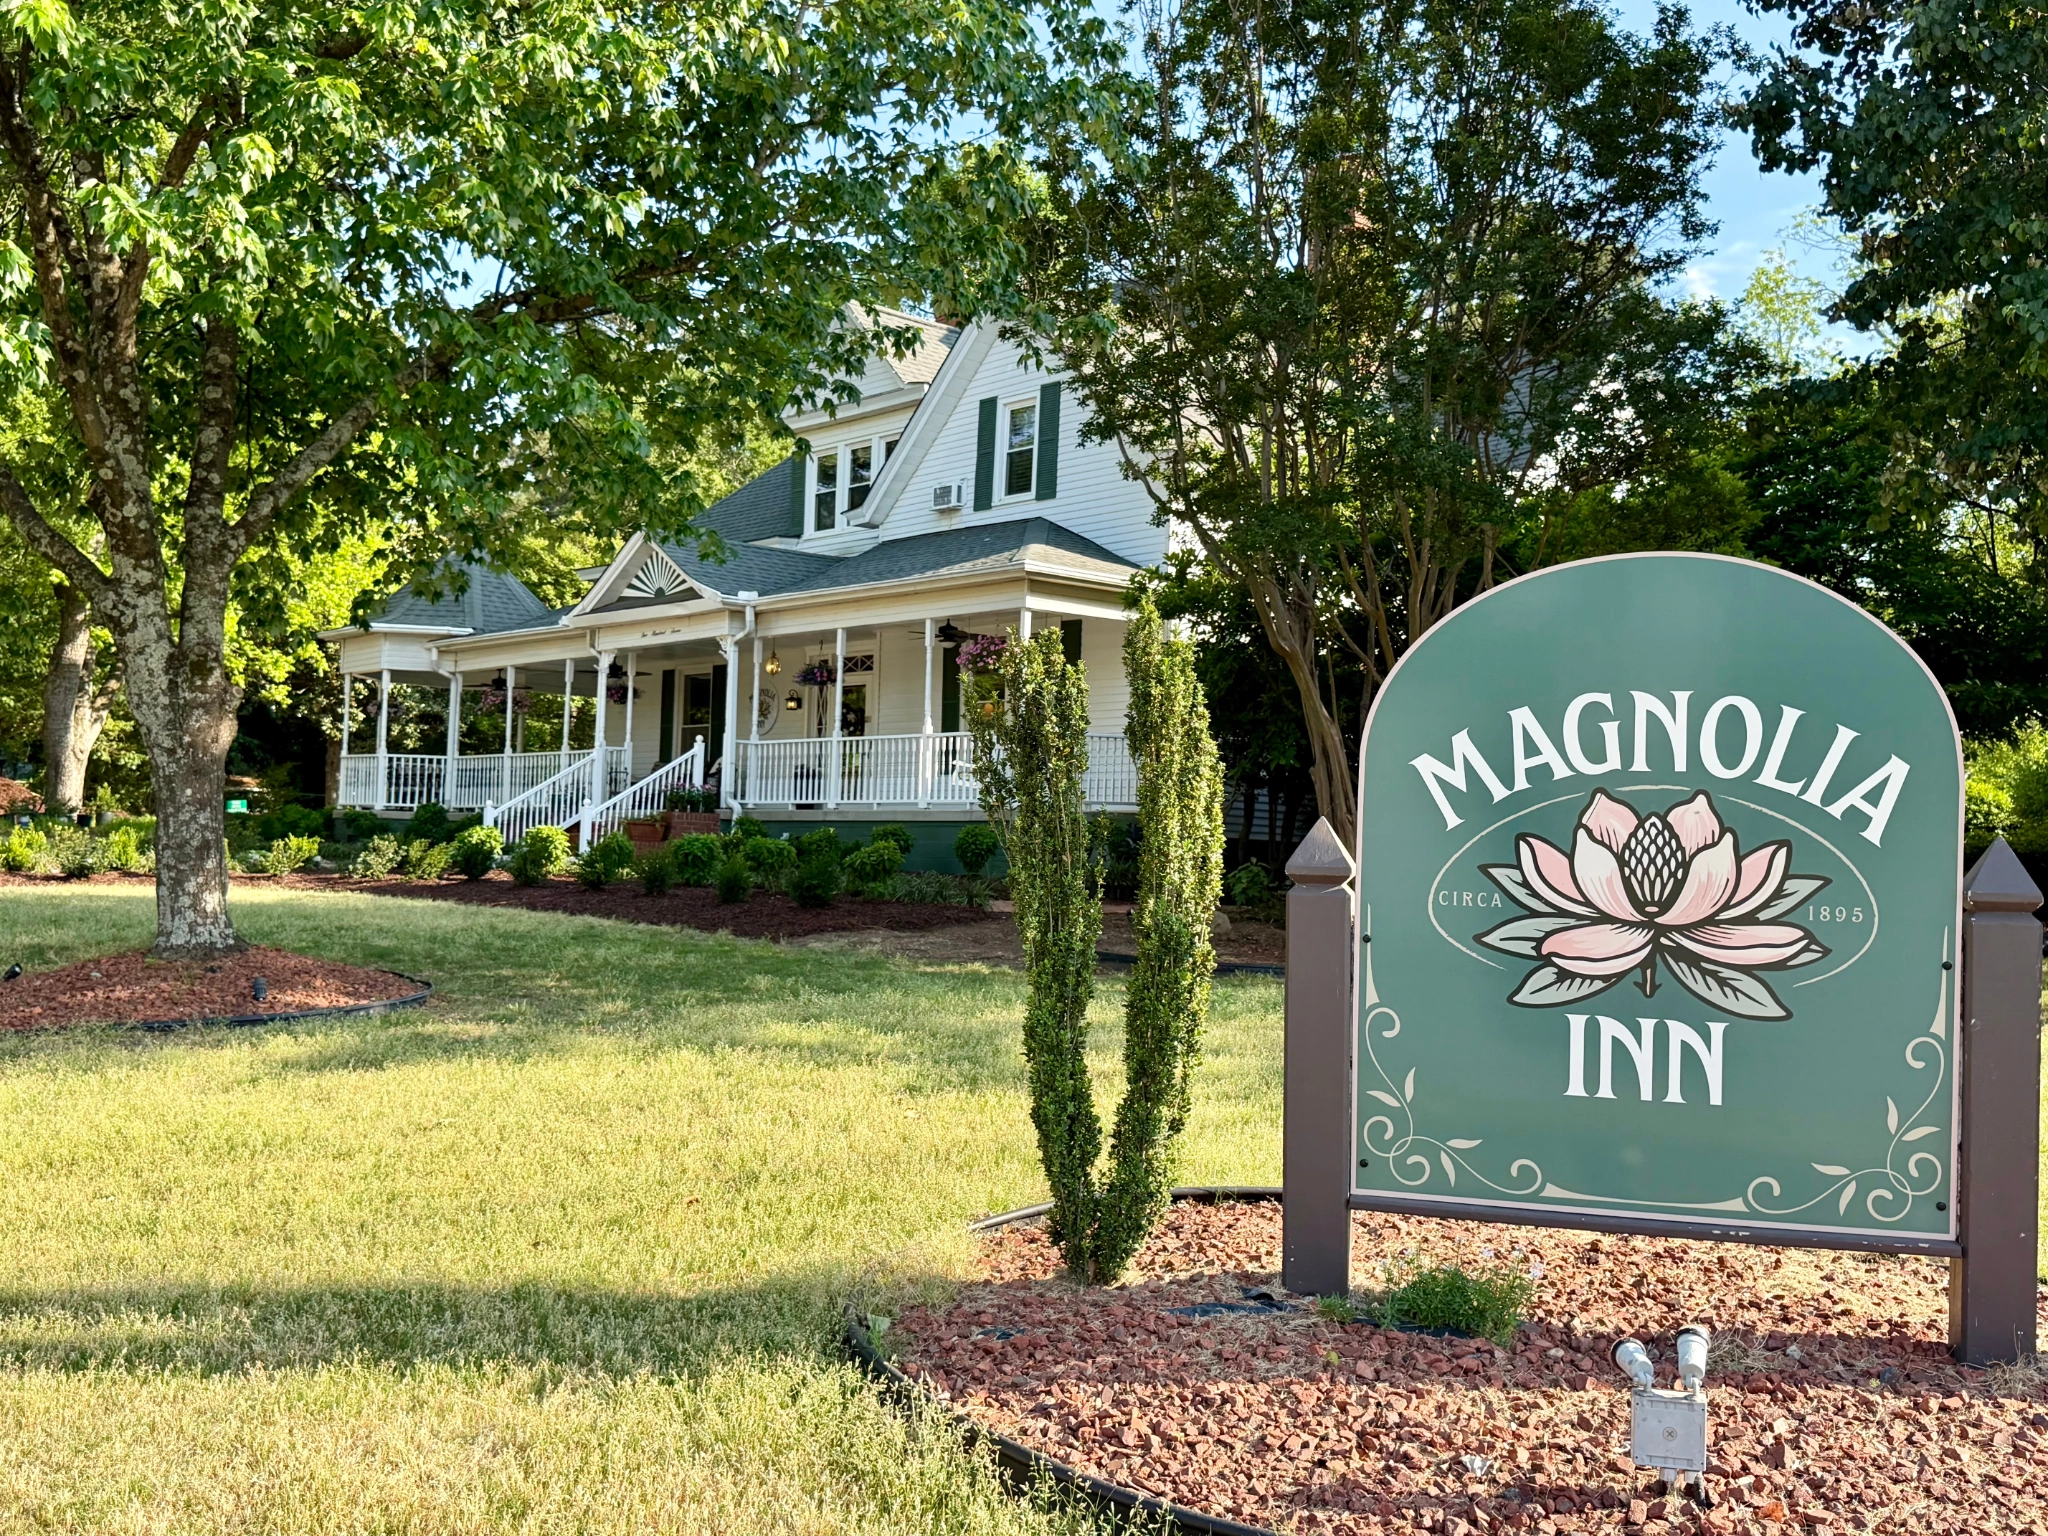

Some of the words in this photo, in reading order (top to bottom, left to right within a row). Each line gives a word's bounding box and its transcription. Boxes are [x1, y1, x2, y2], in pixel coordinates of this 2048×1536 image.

[1408, 690, 1911, 849] MAGNOLIA
[1438, 890, 1503, 908] CIRCA
[1807, 904, 1865, 923] 1895
[1563, 1013, 1730, 1106] INN
